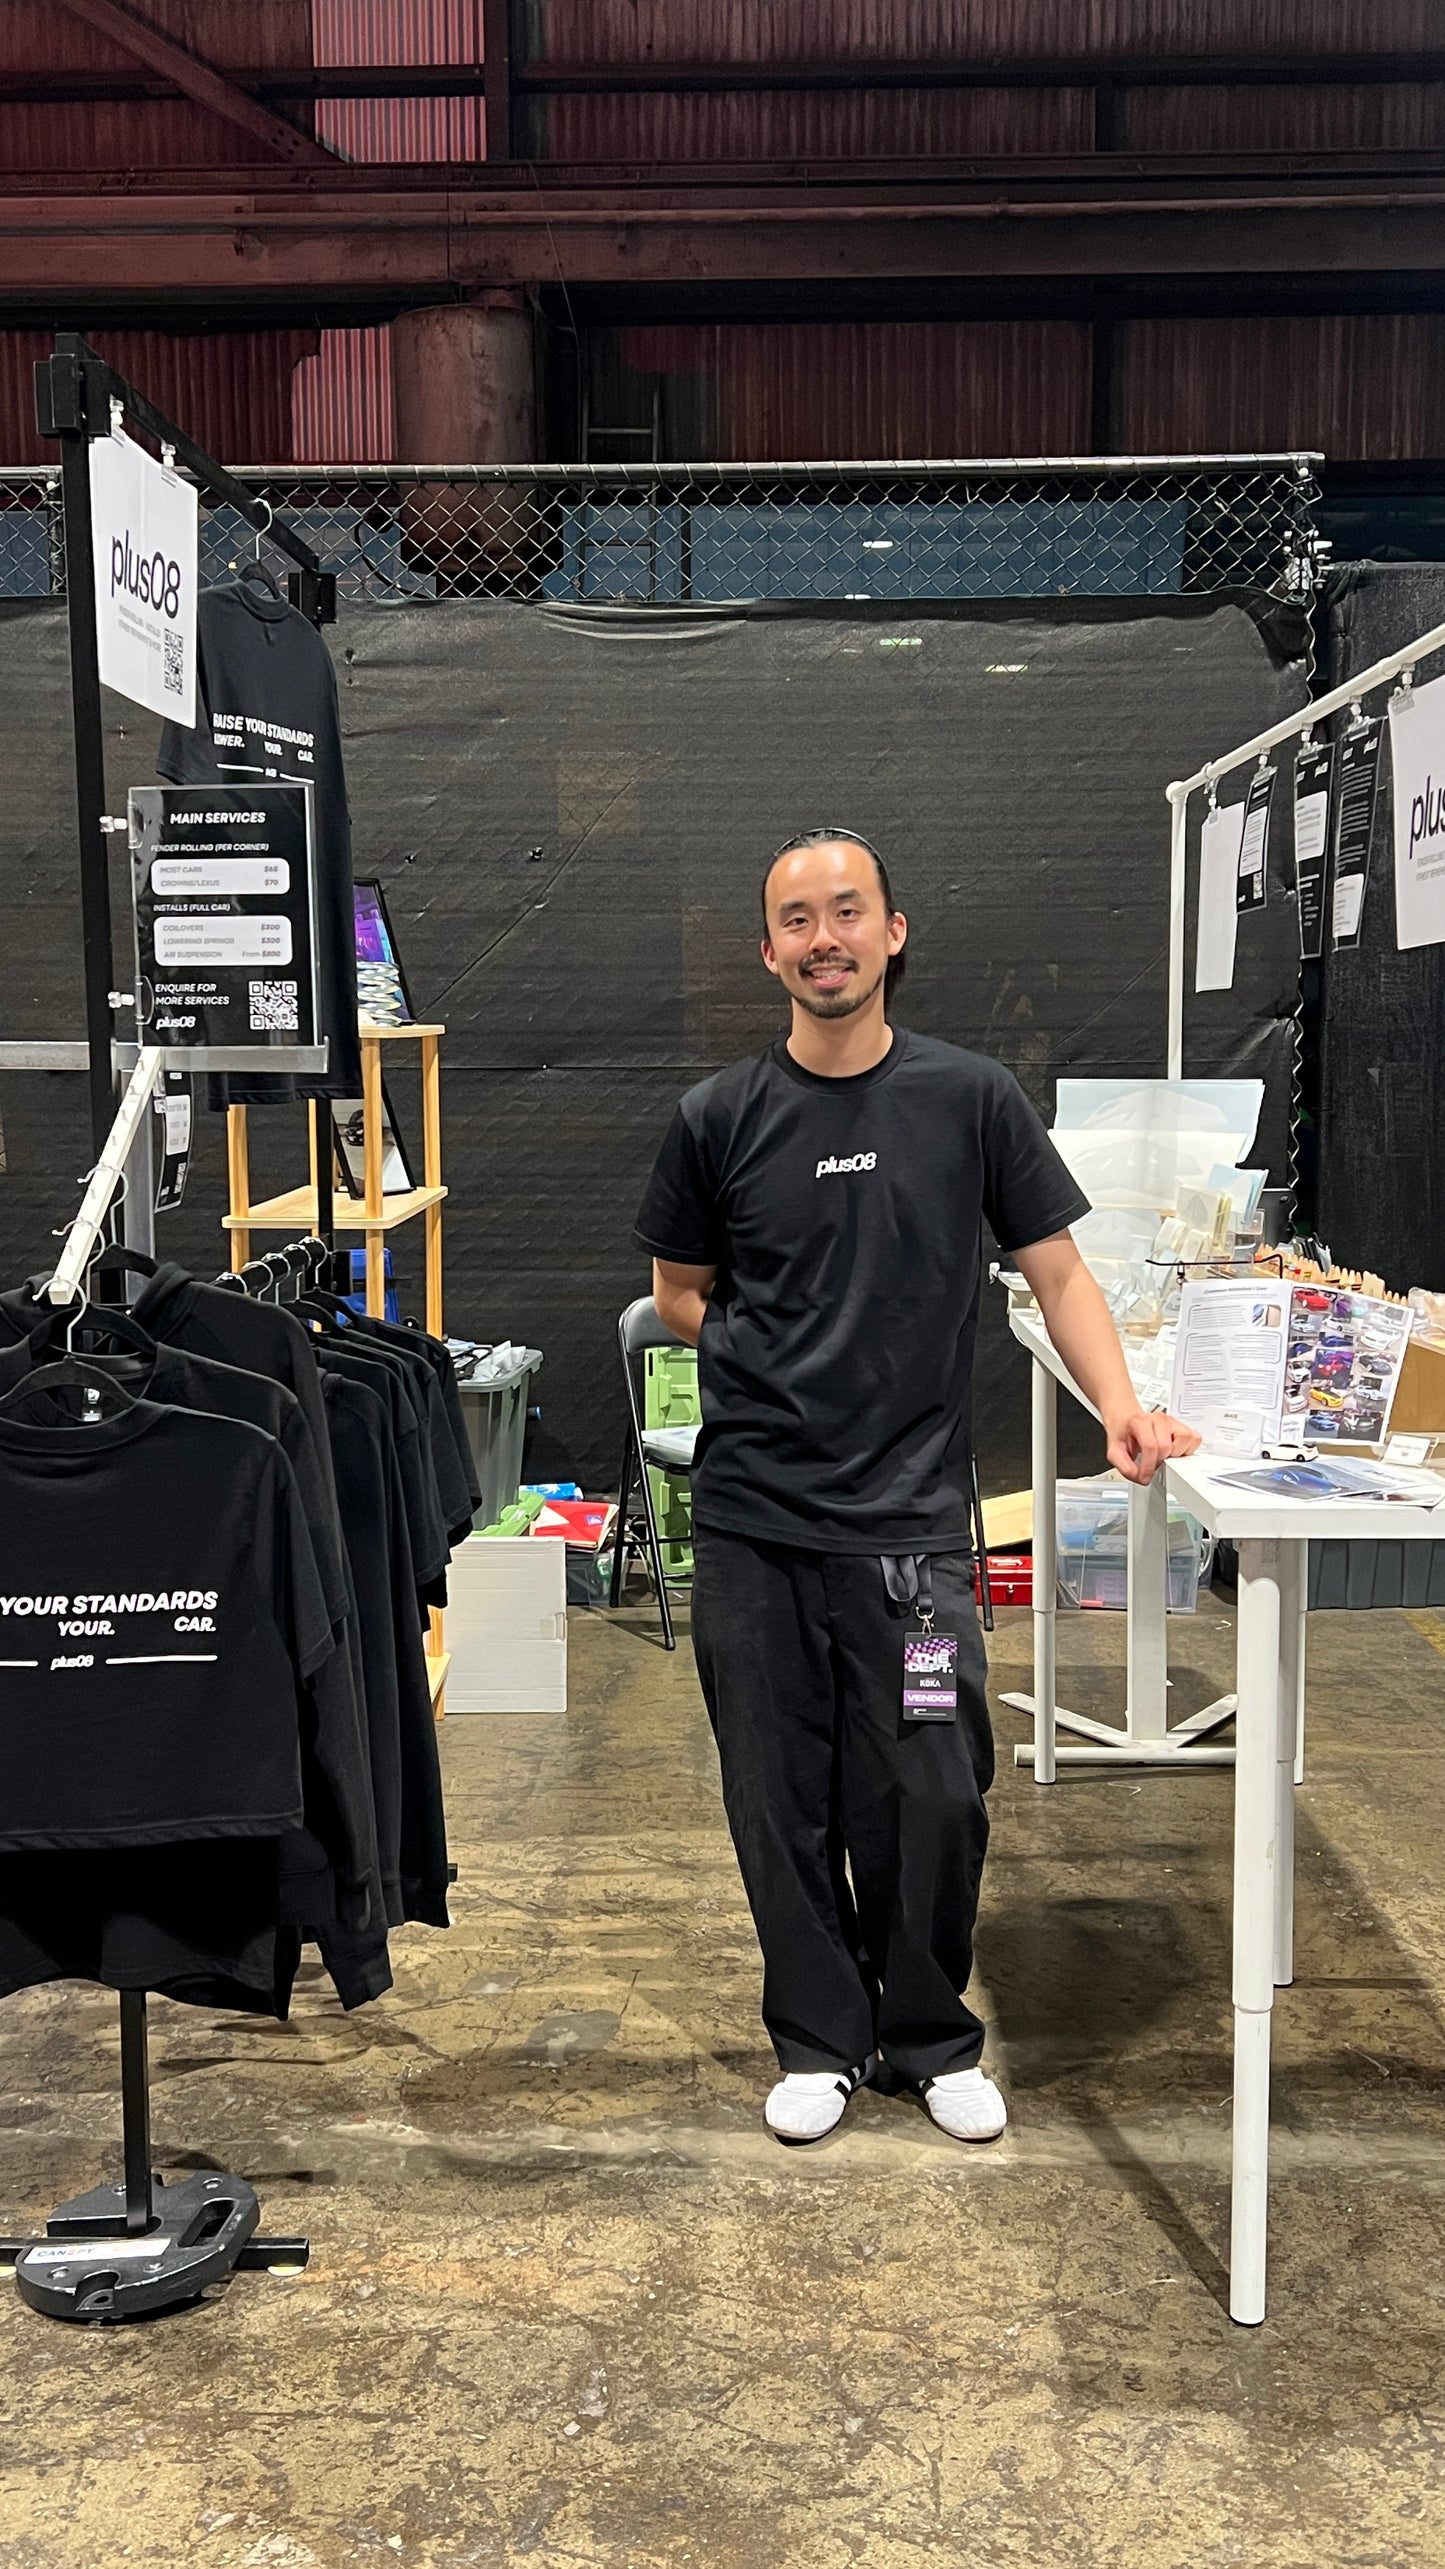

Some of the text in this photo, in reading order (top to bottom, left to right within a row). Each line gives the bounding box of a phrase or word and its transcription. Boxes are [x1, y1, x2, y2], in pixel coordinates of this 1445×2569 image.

[111, 529, 181, 619] plus08
[213, 713, 314, 747] RAISE YOUR STANDARDS
[170, 812, 266, 824] MAIN SERVICES
[150, 843, 270, 852] FENDER ROLLING (PER CORNER)
[189, 904, 209, 912] (FULL
[210, 904, 231, 912] CAR)
[155, 984, 217, 993] ENQUIRE FOR
[156, 996, 230, 1005] MORE SERVICES
[156, 1016, 196, 1030] plus08
[815, 1152, 877, 1178] plus08
[0, 1591, 218, 1616] YOUR STANDARDS
[57, 1616, 216, 1636] YOUR. CAR.
[50, 1655, 95, 1670] plus08
[907, 1694, 954, 1703] VENDOR
